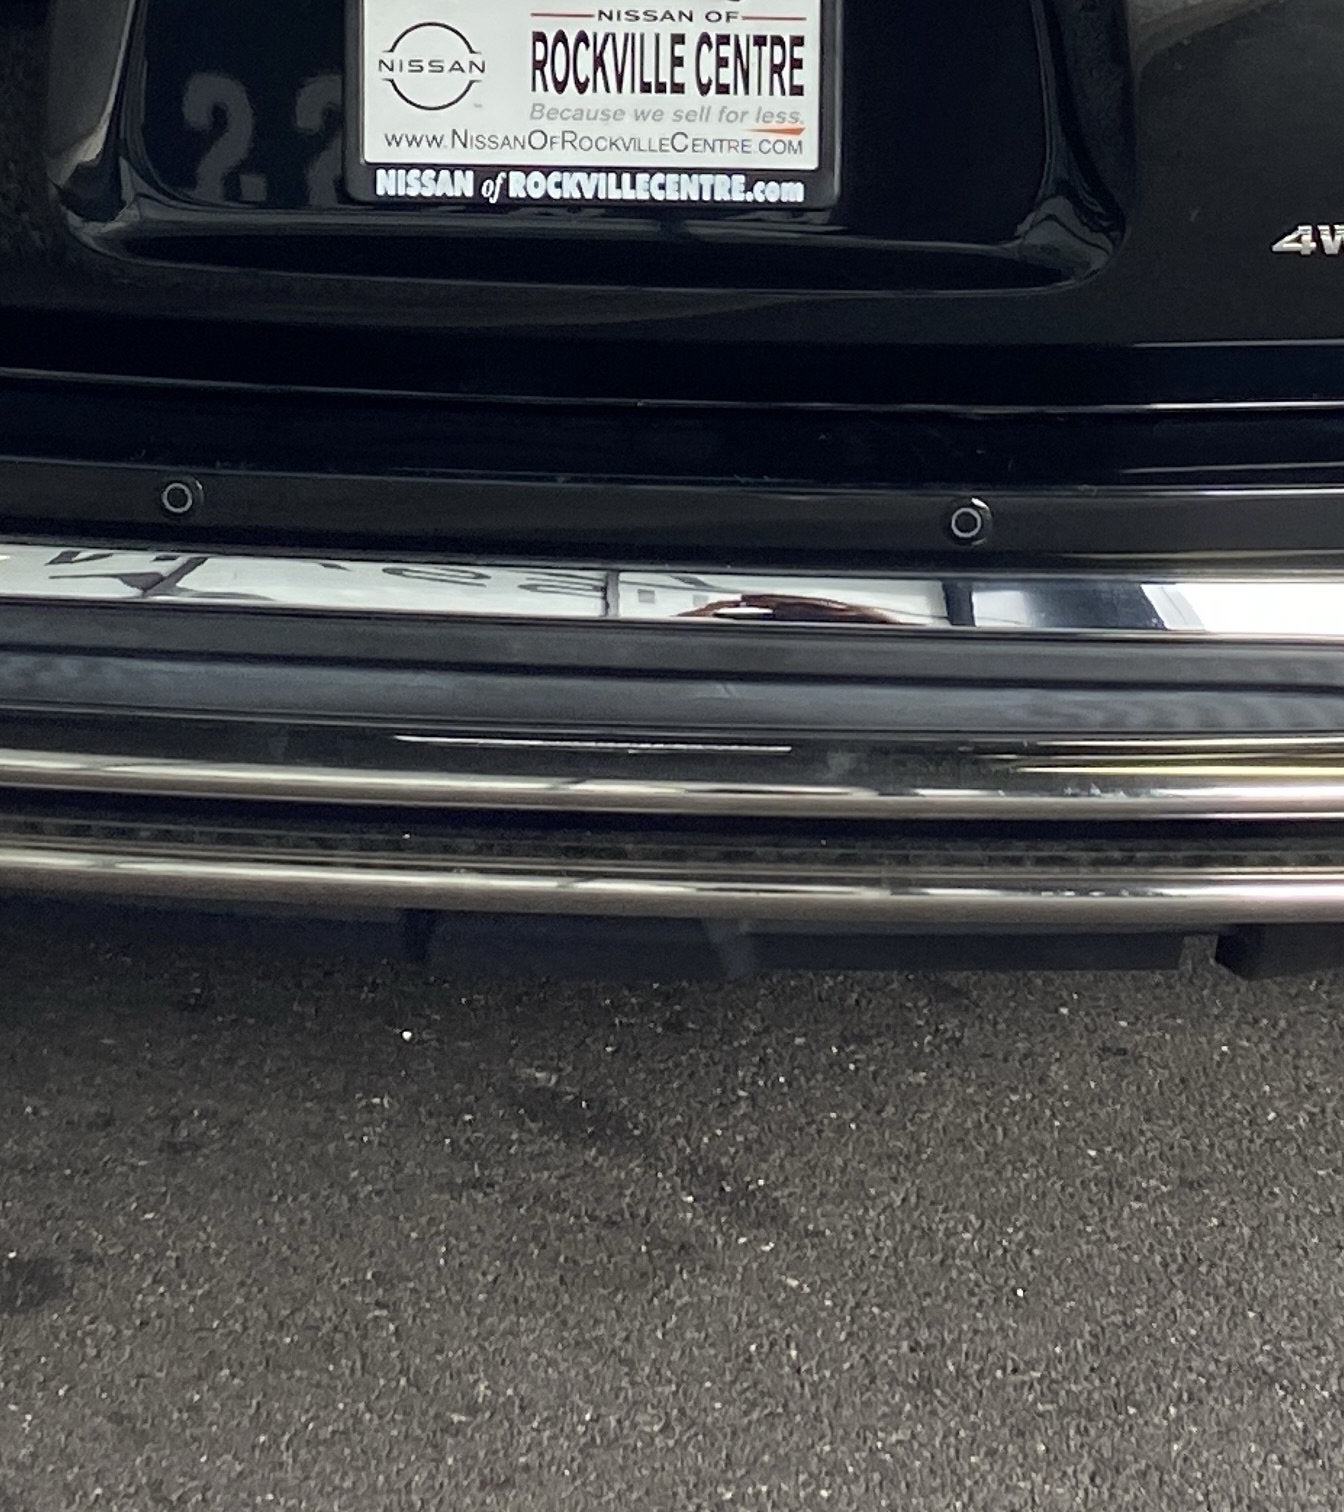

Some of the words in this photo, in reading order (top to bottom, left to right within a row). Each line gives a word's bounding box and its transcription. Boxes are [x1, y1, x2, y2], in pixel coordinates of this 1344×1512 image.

[597, 9, 693, 23] NISSAN
[705, 10, 739, 23] OF
[378, 59, 486, 74] NISSAN
[531, 29, 686, 95] ROCKVILLE
[695, 31, 805, 97] CENTRE
[529, 103, 626, 123] Because
[633, 107, 665, 123] we
[672, 105, 712, 123] sell
[717, 105, 748, 124] for
[755, 106, 805, 124] less.
[375, 168, 475, 197] NISSAN
[481, 172, 507, 204] of
[508, 170, 805, 202] ROCKVILLECENTRE.com
